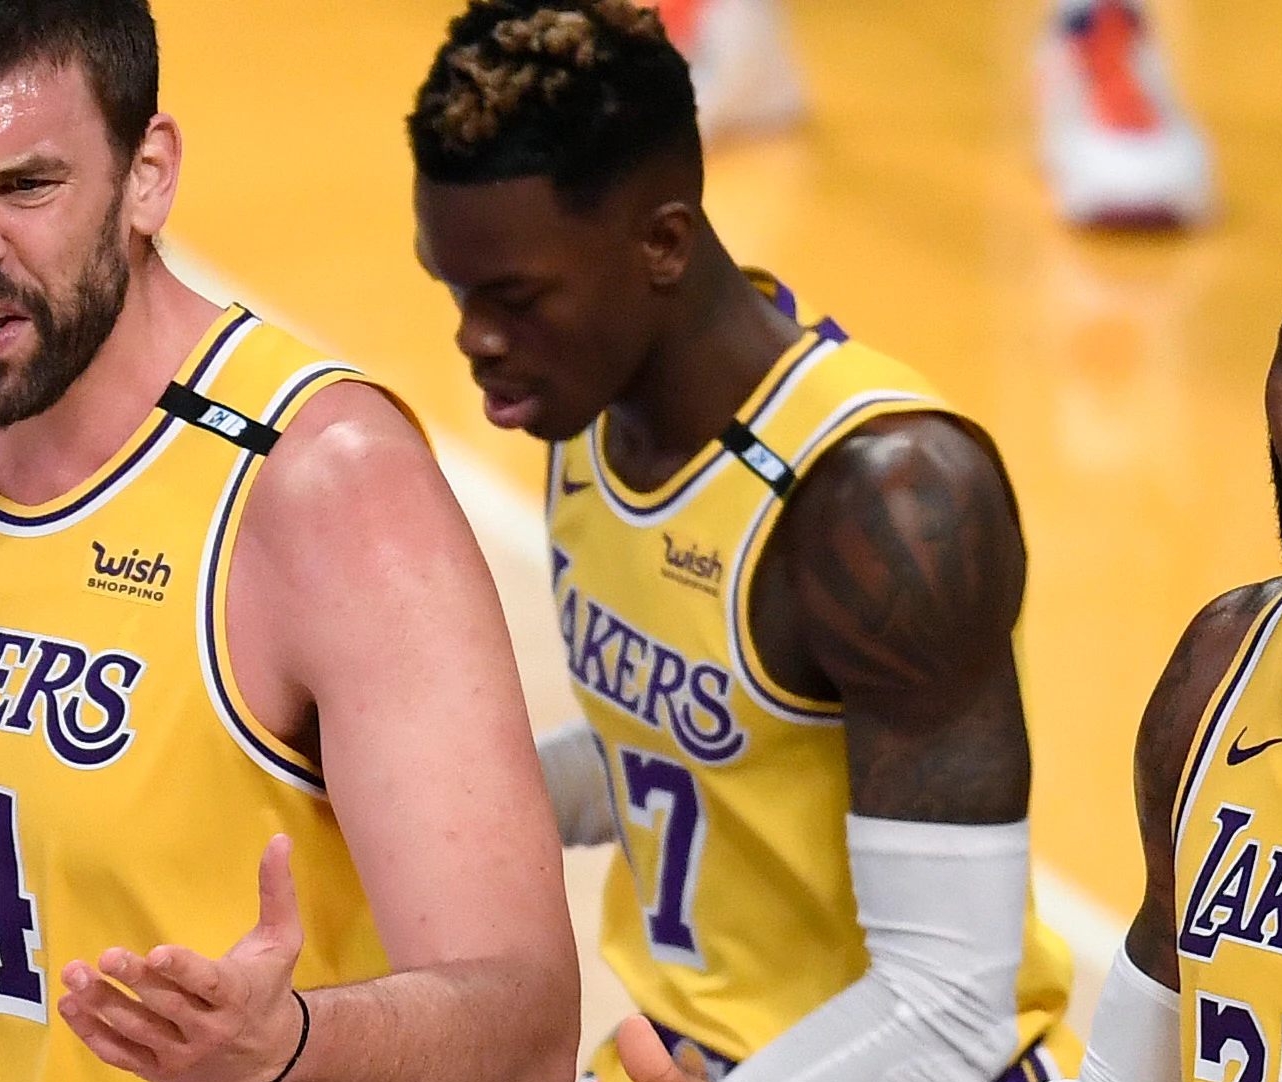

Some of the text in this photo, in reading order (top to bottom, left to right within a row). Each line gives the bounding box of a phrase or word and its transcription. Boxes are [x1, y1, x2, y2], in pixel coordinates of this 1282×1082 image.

[91, 540, 172, 588] wish
[663, 531, 723, 584] wish
[87, 577, 165, 602] SHOPPING
[551, 546, 748, 766] AKERS
